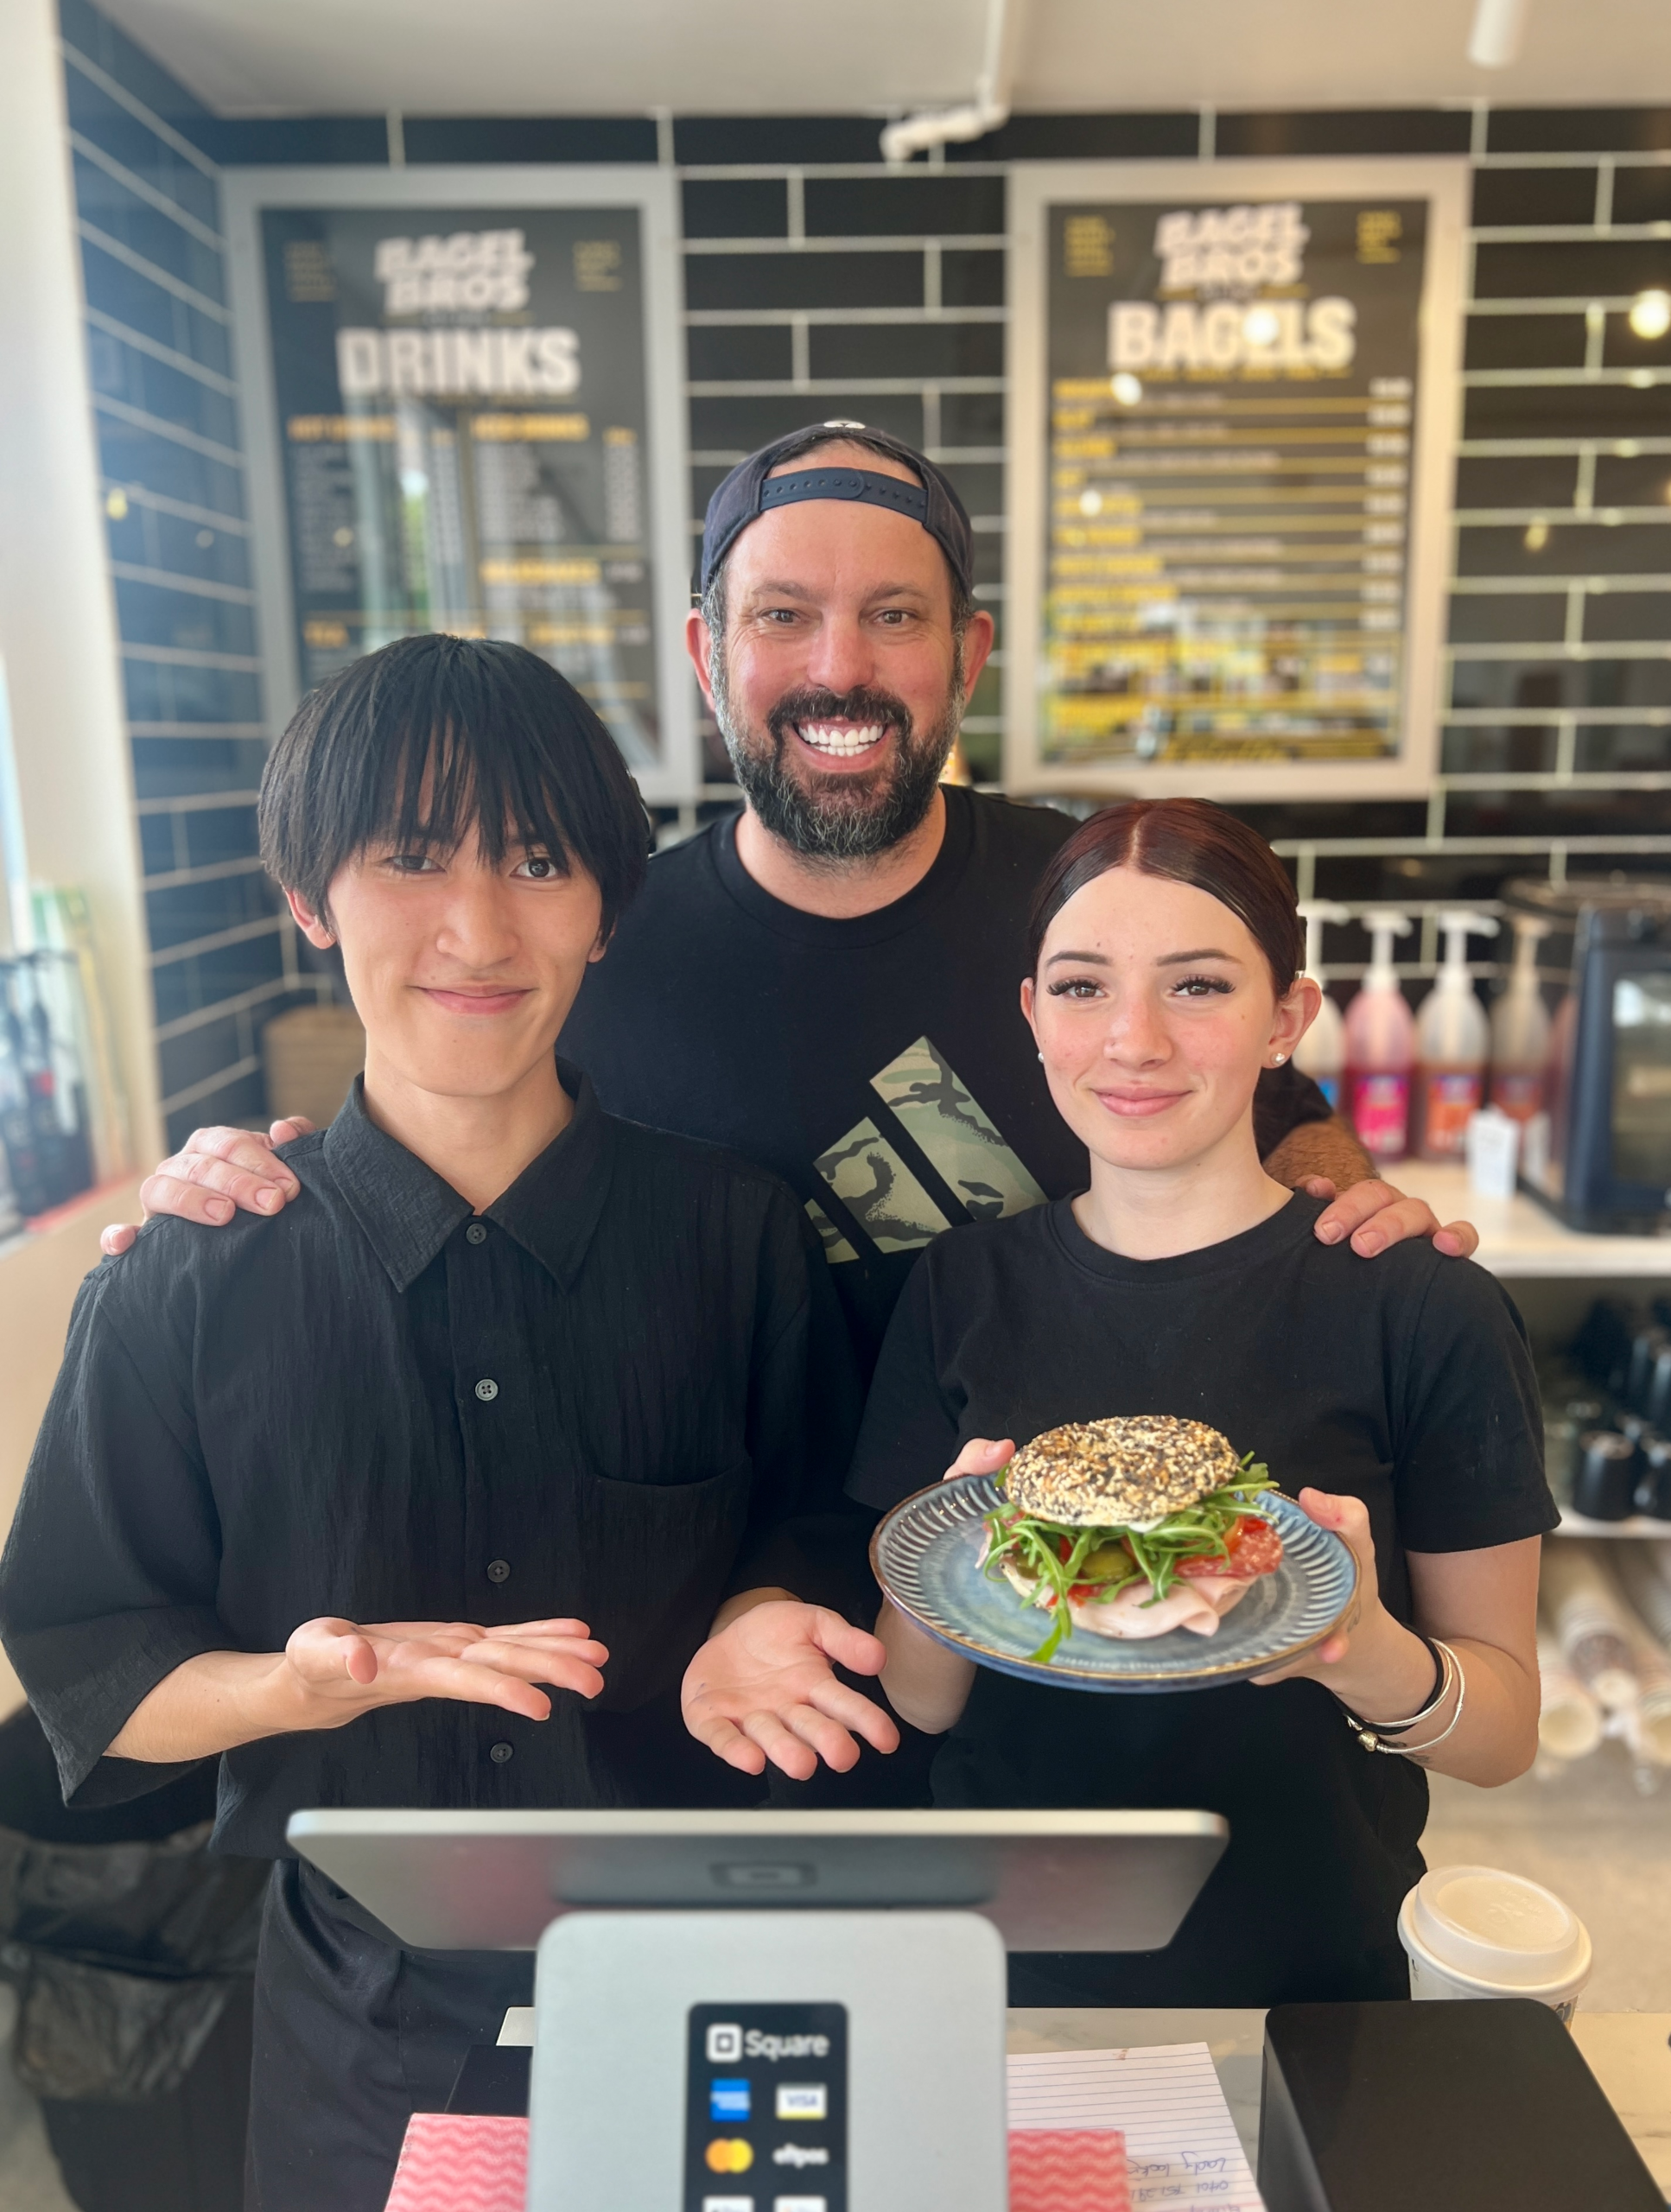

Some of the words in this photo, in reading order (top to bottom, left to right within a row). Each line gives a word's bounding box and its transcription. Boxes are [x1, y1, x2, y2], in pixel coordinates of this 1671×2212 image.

[337, 327, 580, 395] DRINKS
[745, 2029, 829, 2063] Square
[786, 2093, 818, 2107] VISA
